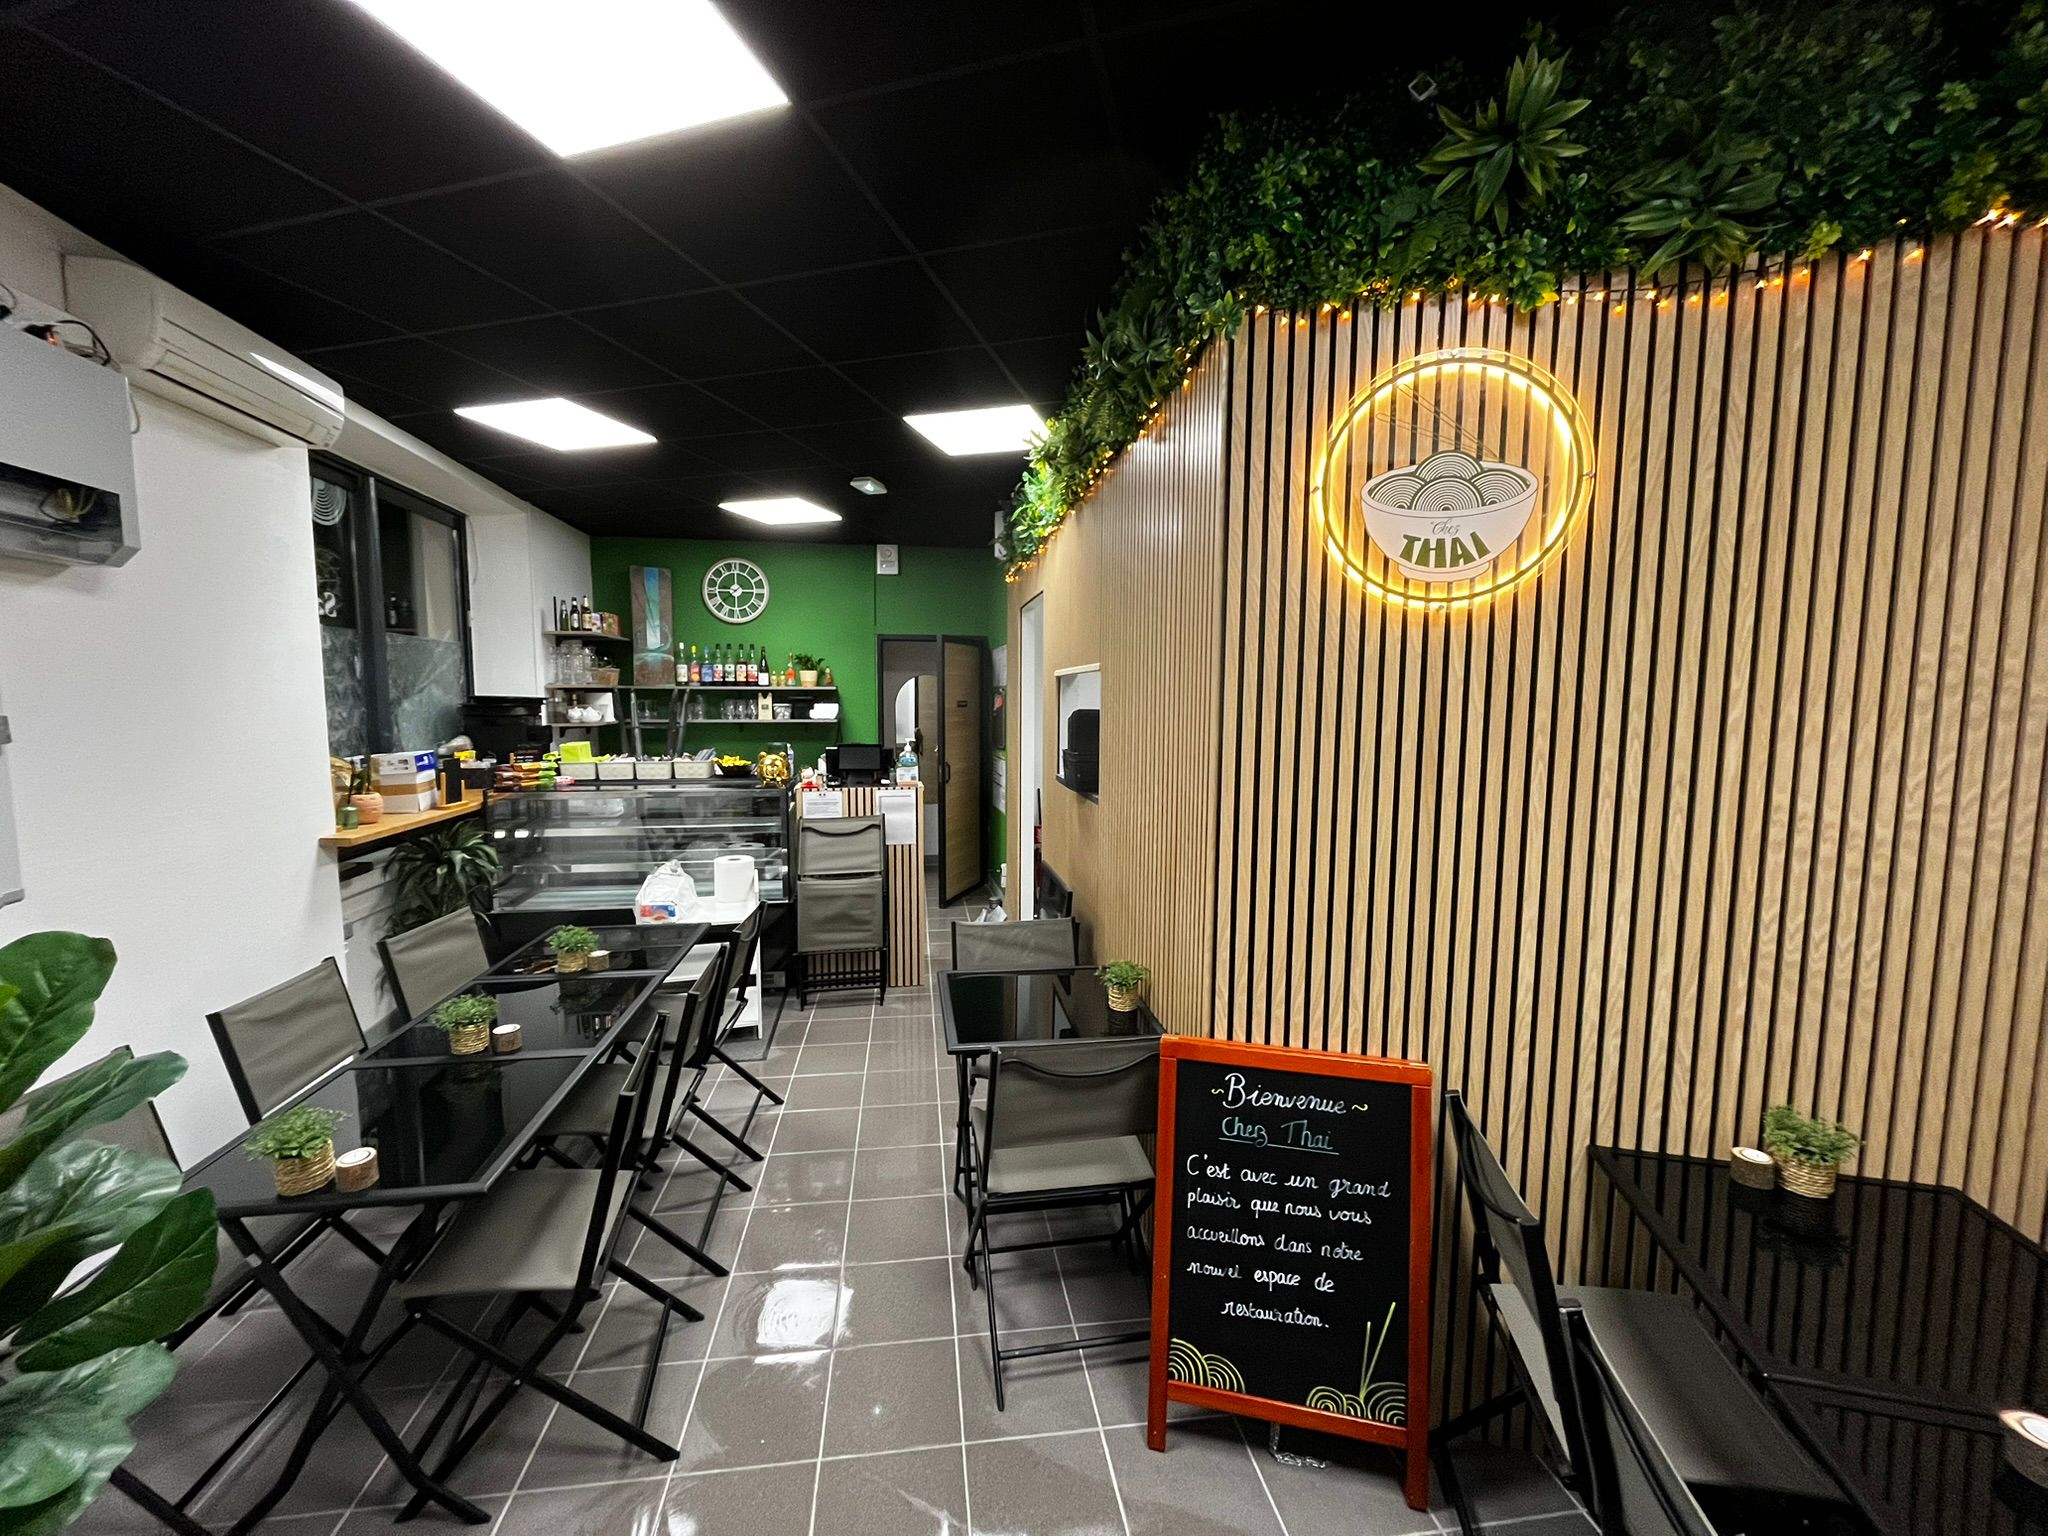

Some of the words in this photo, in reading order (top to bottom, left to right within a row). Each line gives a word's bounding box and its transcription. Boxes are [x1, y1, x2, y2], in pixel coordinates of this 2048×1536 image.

[1400, 531, 1491, 568] THAI
[1222, 1073, 1347, 1114] Bienvenue
[1221, 1117, 1268, 1148] Chez
[1281, 1119, 1333, 1150] Thai
[1187, 1154, 1231, 1180] C'est
[1240, 1168, 1278, 1186] avec
[1284, 1174, 1319, 1189] un
[1328, 1178, 1391, 1199] grand
[1187, 1187, 1241, 1209] plaisir
[1251, 1199, 1280, 1219] que
[1284, 1202, 1322, 1218] nous
[1329, 1208, 1372, 1225] vous
[1187, 1225, 1265, 1247] accueillons
[1274, 1234, 1312, 1254] dans
[1321, 1241, 1364, 1261] notre
[1254, 1269, 1301, 1292] espace
[1314, 1272, 1335, 1293] de
